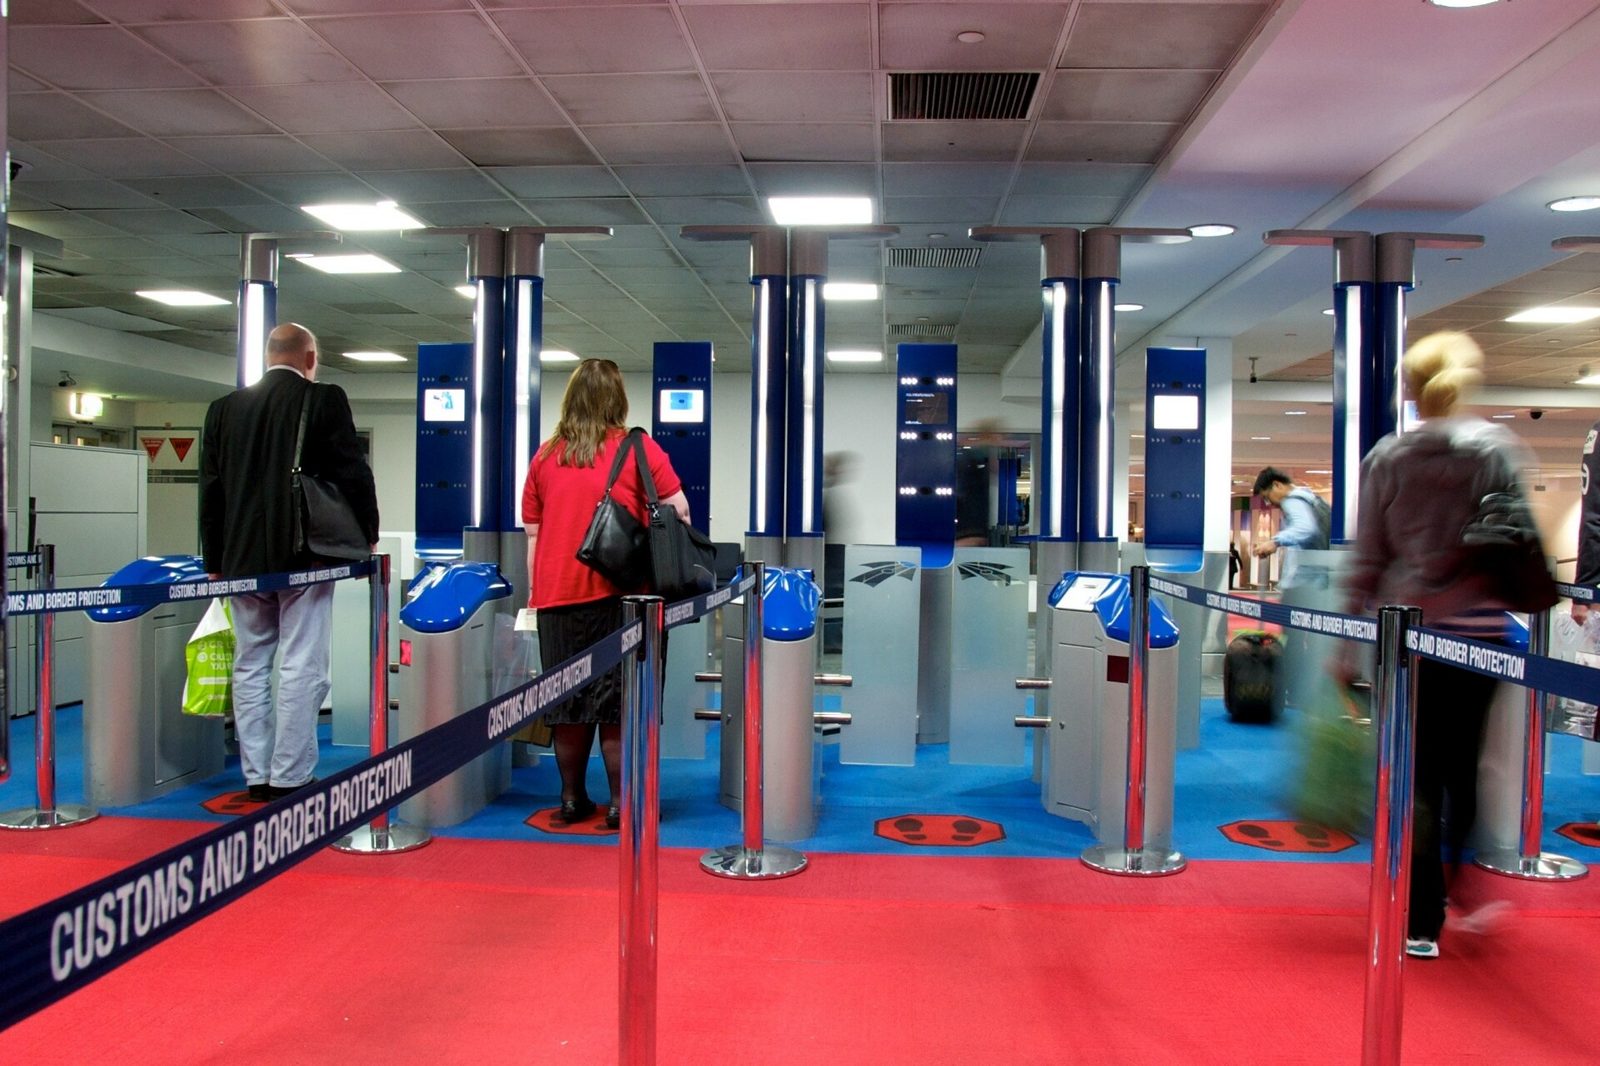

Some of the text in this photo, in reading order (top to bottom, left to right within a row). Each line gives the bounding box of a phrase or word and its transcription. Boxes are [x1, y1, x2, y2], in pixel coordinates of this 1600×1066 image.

[26, 594, 45, 610] AND
[45, 591, 76, 609] BORDER
[78, 588, 121, 608] PROTECTION
[169, 578, 258, 600] CUSTOMS AND BORDER PROTECTION
[1290, 610, 1377, 641] CUSTOMS AND BORDER PROTECTION
[1418, 632, 1435, 655] AND
[1435, 637, 1468, 665] BORDER
[1469, 645, 1525, 680] PROTECTION
[488, 653, 592, 739] CUSTOMS AND BORDER PROTECTION
[51, 749, 412, 982] CUSTOMS AND BORDER PROTECTION
